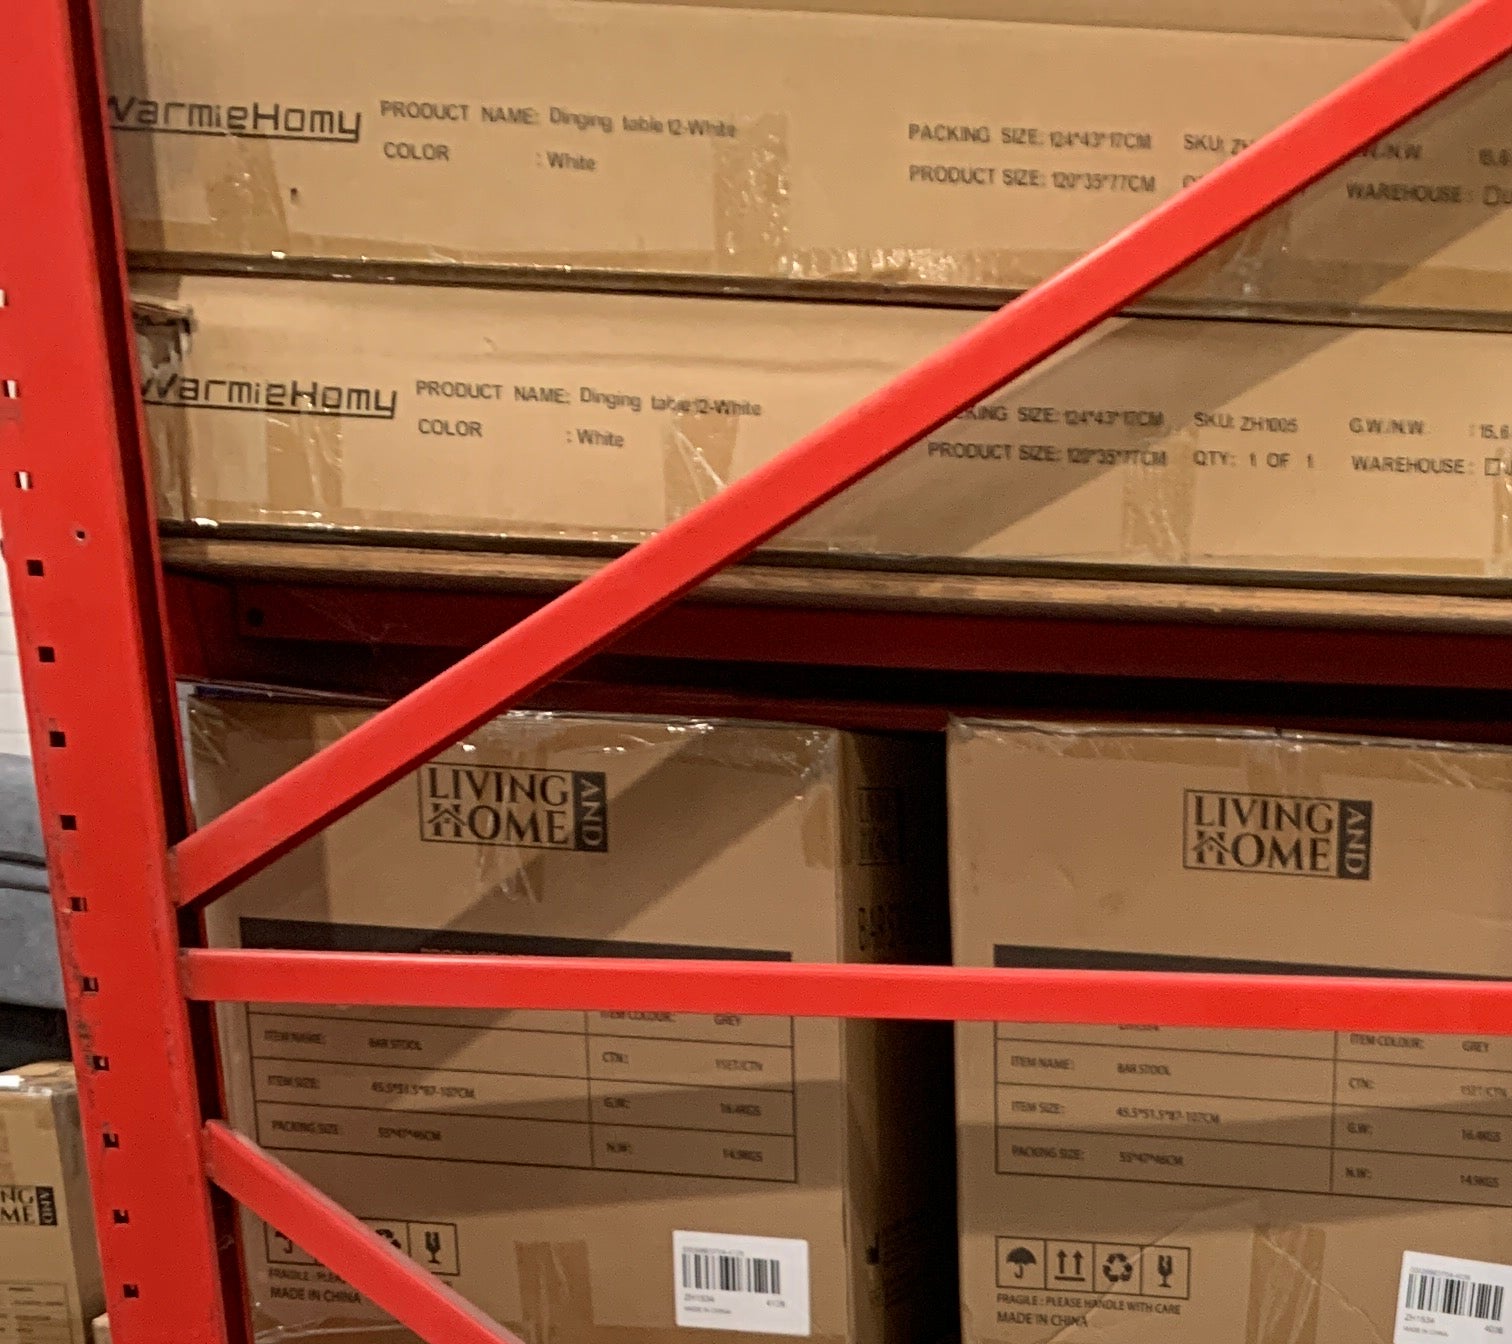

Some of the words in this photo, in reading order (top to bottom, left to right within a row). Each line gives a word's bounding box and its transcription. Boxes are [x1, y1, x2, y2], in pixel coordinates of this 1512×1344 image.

[380, 100, 468, 121] PRODUCT
[908, 123, 990, 144] PACKING
[384, 141, 449, 160] COLOR
[909, 165, 995, 185] PRODUCT
[416, 381, 503, 400] PRODUCT
[580, 387, 642, 411] Dinging
[418, 418, 482, 437] COLOR
[577, 429, 625, 447] White
[928, 442, 1012, 460] PRODUCT
[1267, 453, 1291, 469] OF
[428, 767, 568, 806] LIVING
[428, 803, 569, 844] HOME
[581, 778, 603, 847] AND
[1195, 796, 1333, 835] LIVING
[1193, 830, 1331, 872] HOME
[1346, 806, 1366, 873] AND
[39, 1190, 54, 1224] AND
[270, 1286, 304, 1300] MADE
[997, 1293, 1038, 1306] FRAGILE
[1046, 1296, 1082, 1308] PLEASE
[1084, 1298, 1124, 1311] HANDLE
[1127, 1302, 1152, 1313] WITH
[1155, 1303, 1181, 1315] CARE
[997, 1311, 1032, 1324] MADE
[1035, 1313, 1048, 1325] IN
[1051, 1314, 1089, 1327] CHINA
